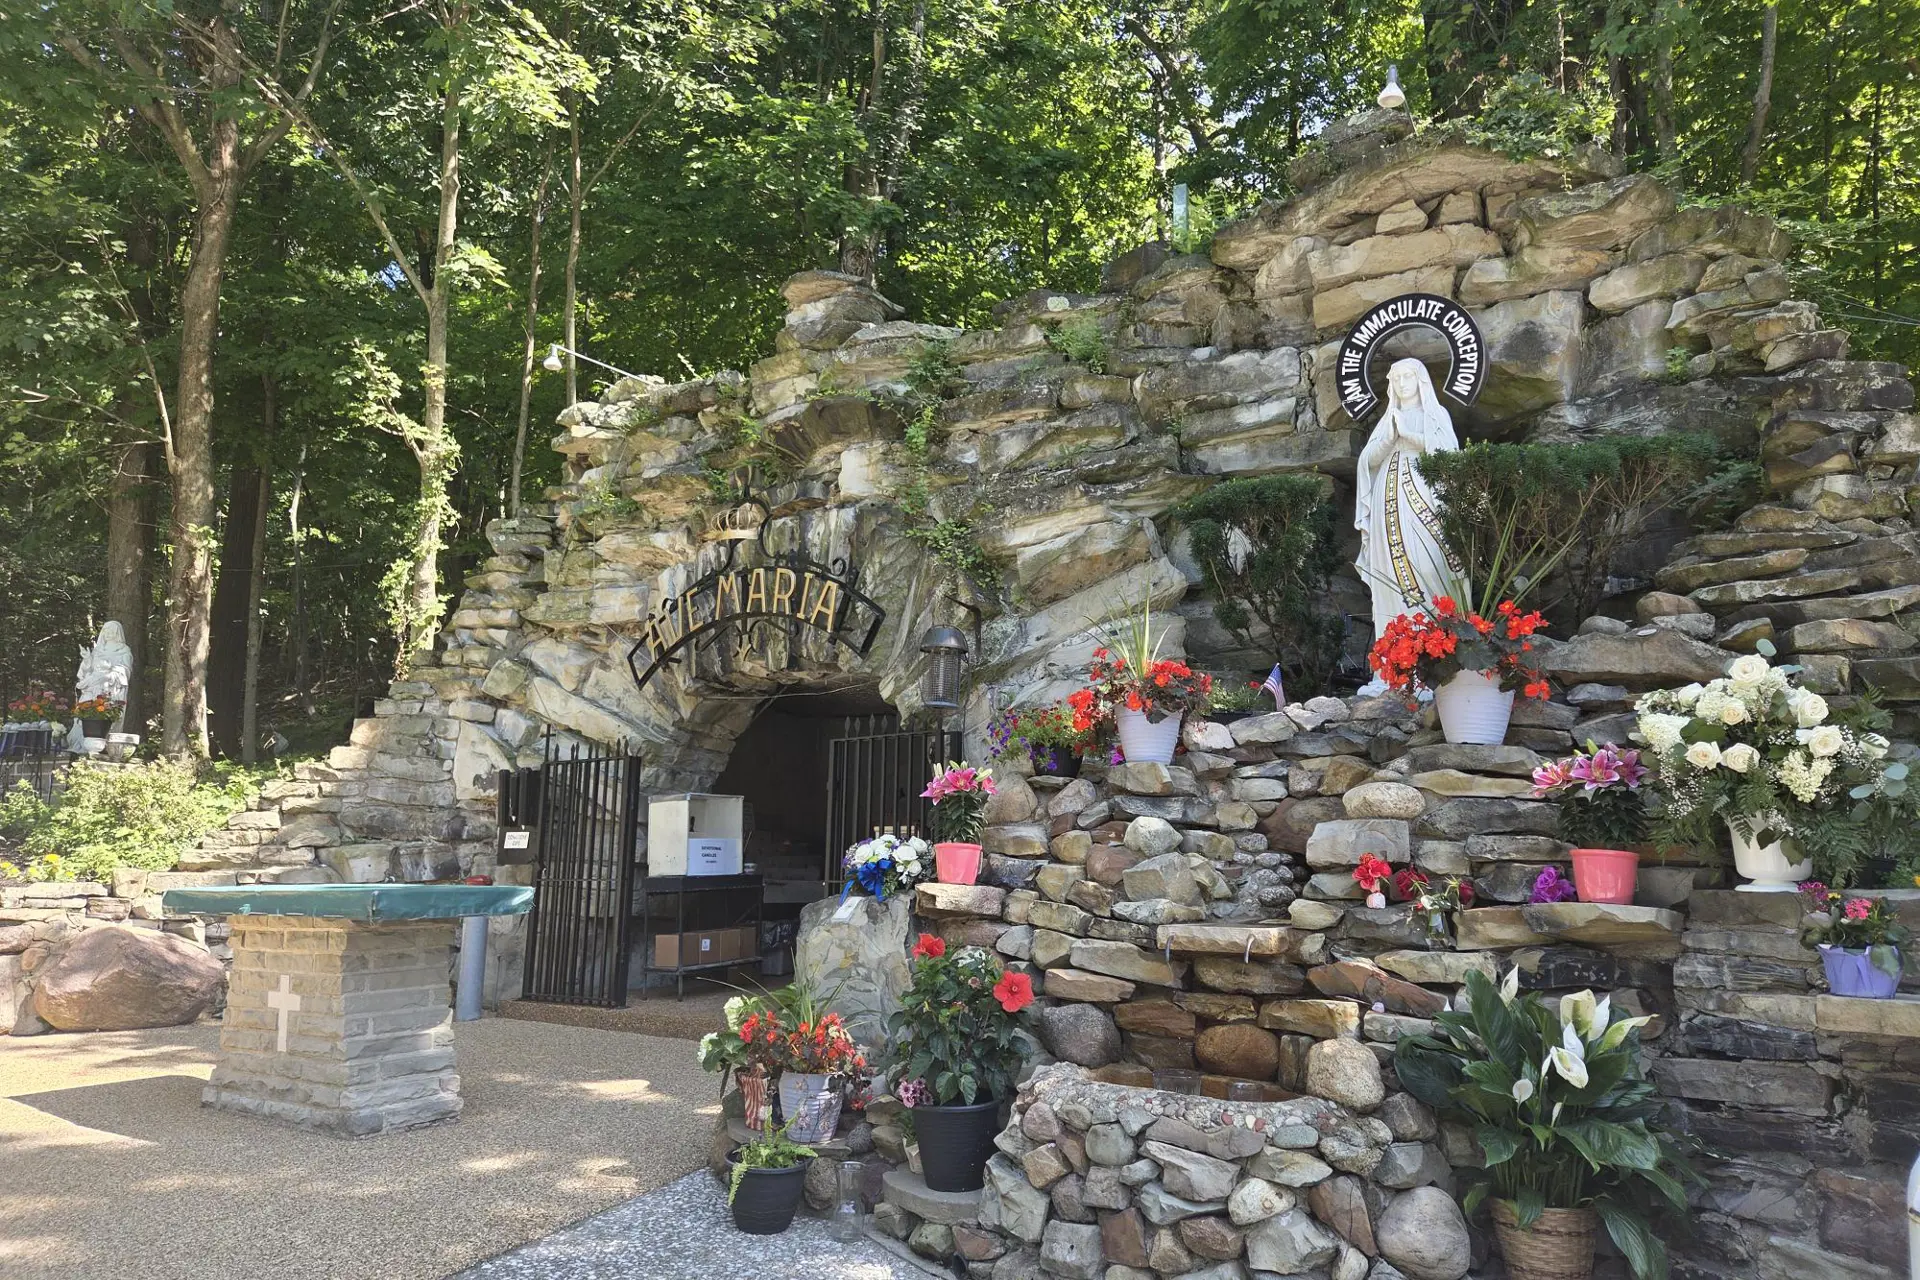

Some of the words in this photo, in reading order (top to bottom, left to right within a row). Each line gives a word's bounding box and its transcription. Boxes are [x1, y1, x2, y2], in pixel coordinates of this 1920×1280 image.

[1351, 299, 1445, 348] IMMACULATE
[1341, 347, 1363, 376] THE
[1442, 310, 1478, 396] CONCEPTION
[1342, 377, 1372, 403] AM
[1353, 399, 1369, 412] I
[648, 586, 704, 664] AVE
[715, 567, 839, 633] MARIA
